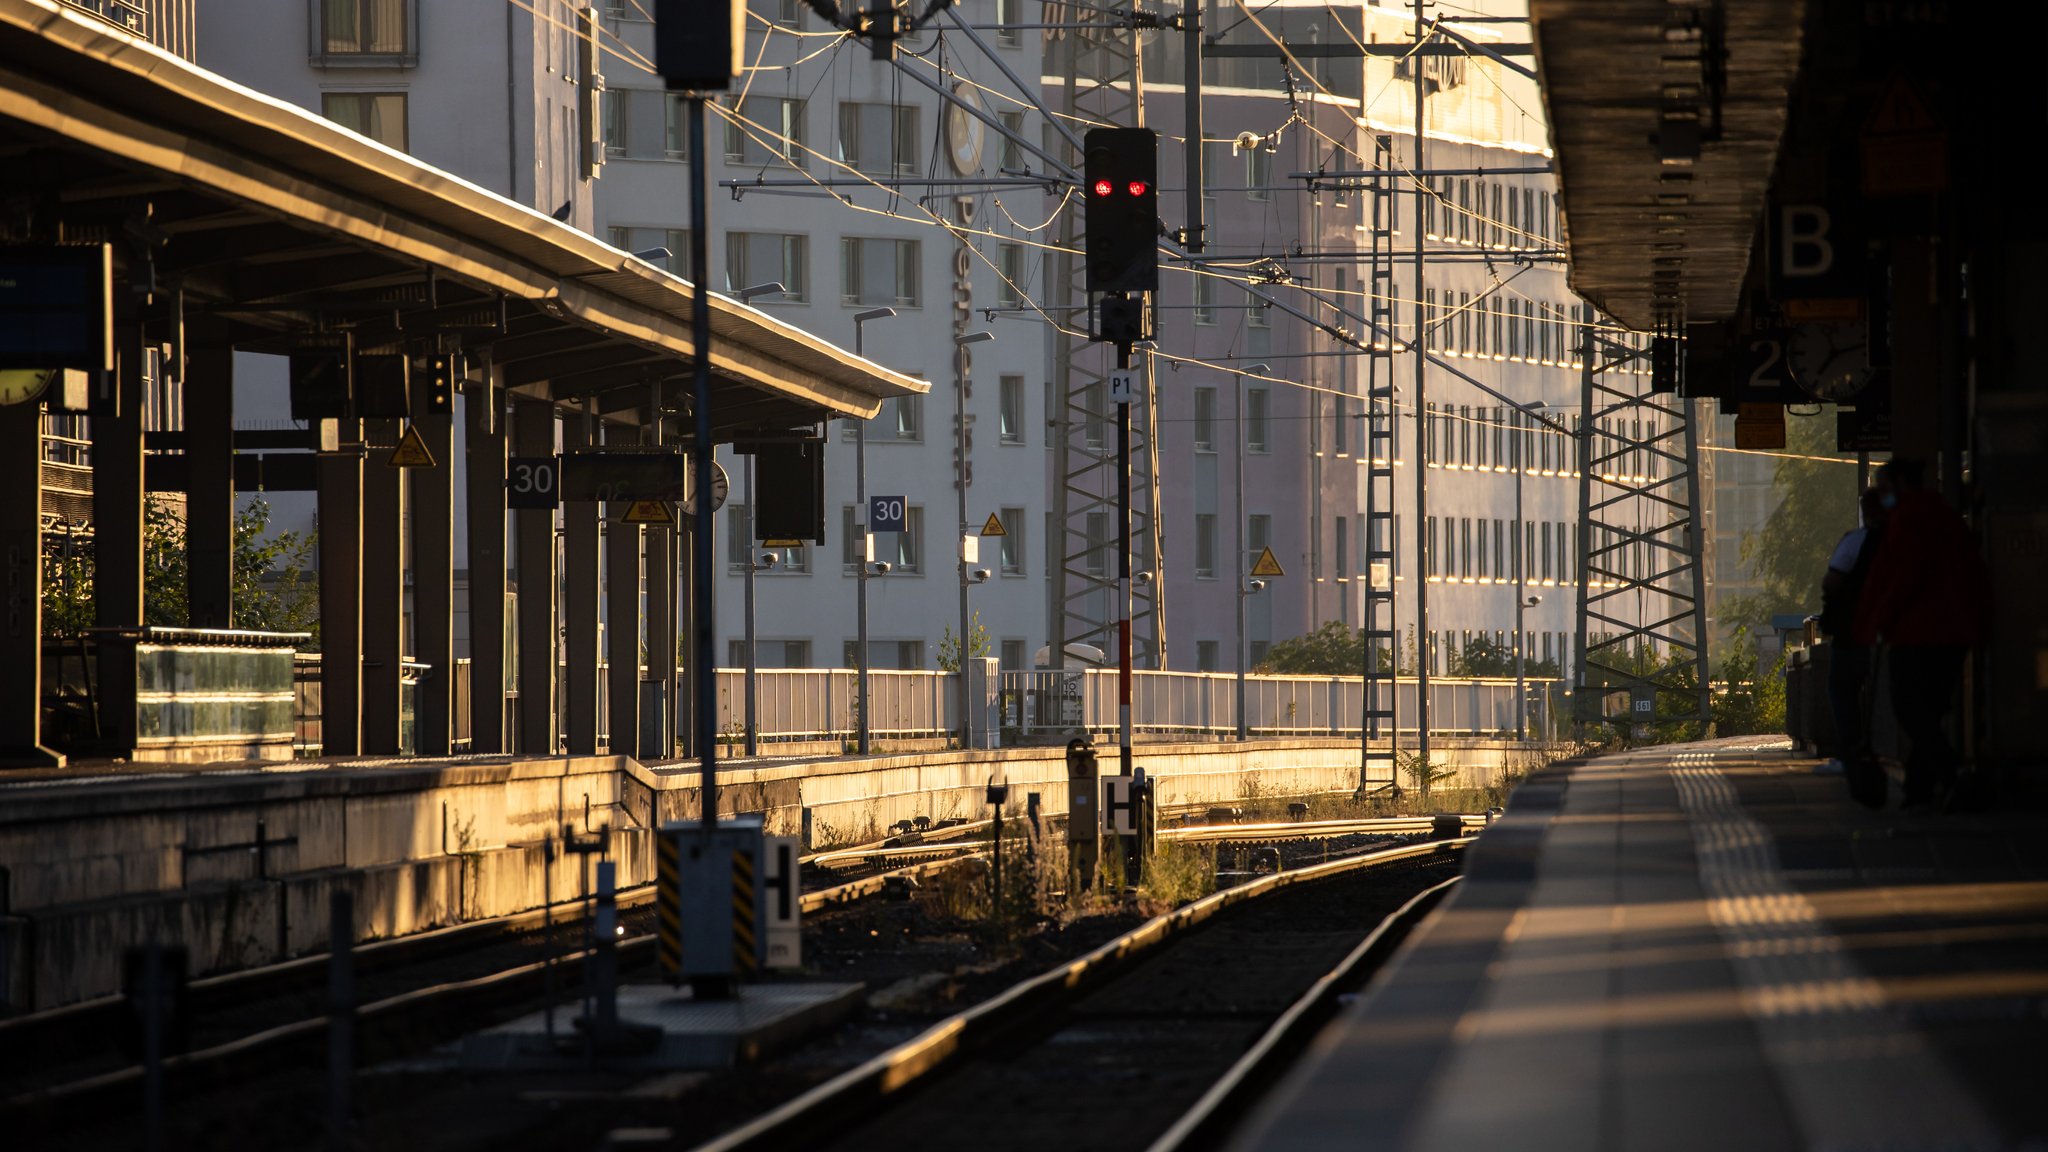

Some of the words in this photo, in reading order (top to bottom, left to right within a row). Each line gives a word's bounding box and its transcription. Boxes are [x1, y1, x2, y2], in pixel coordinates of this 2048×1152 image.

[1780, 205, 1834, 278] B
[1748, 338, 1783, 388] 2
[1113, 377, 1130, 394] P1
[514, 465, 553, 493] 30
[876, 501, 902, 521] 30
[1107, 782, 1137, 830] H
